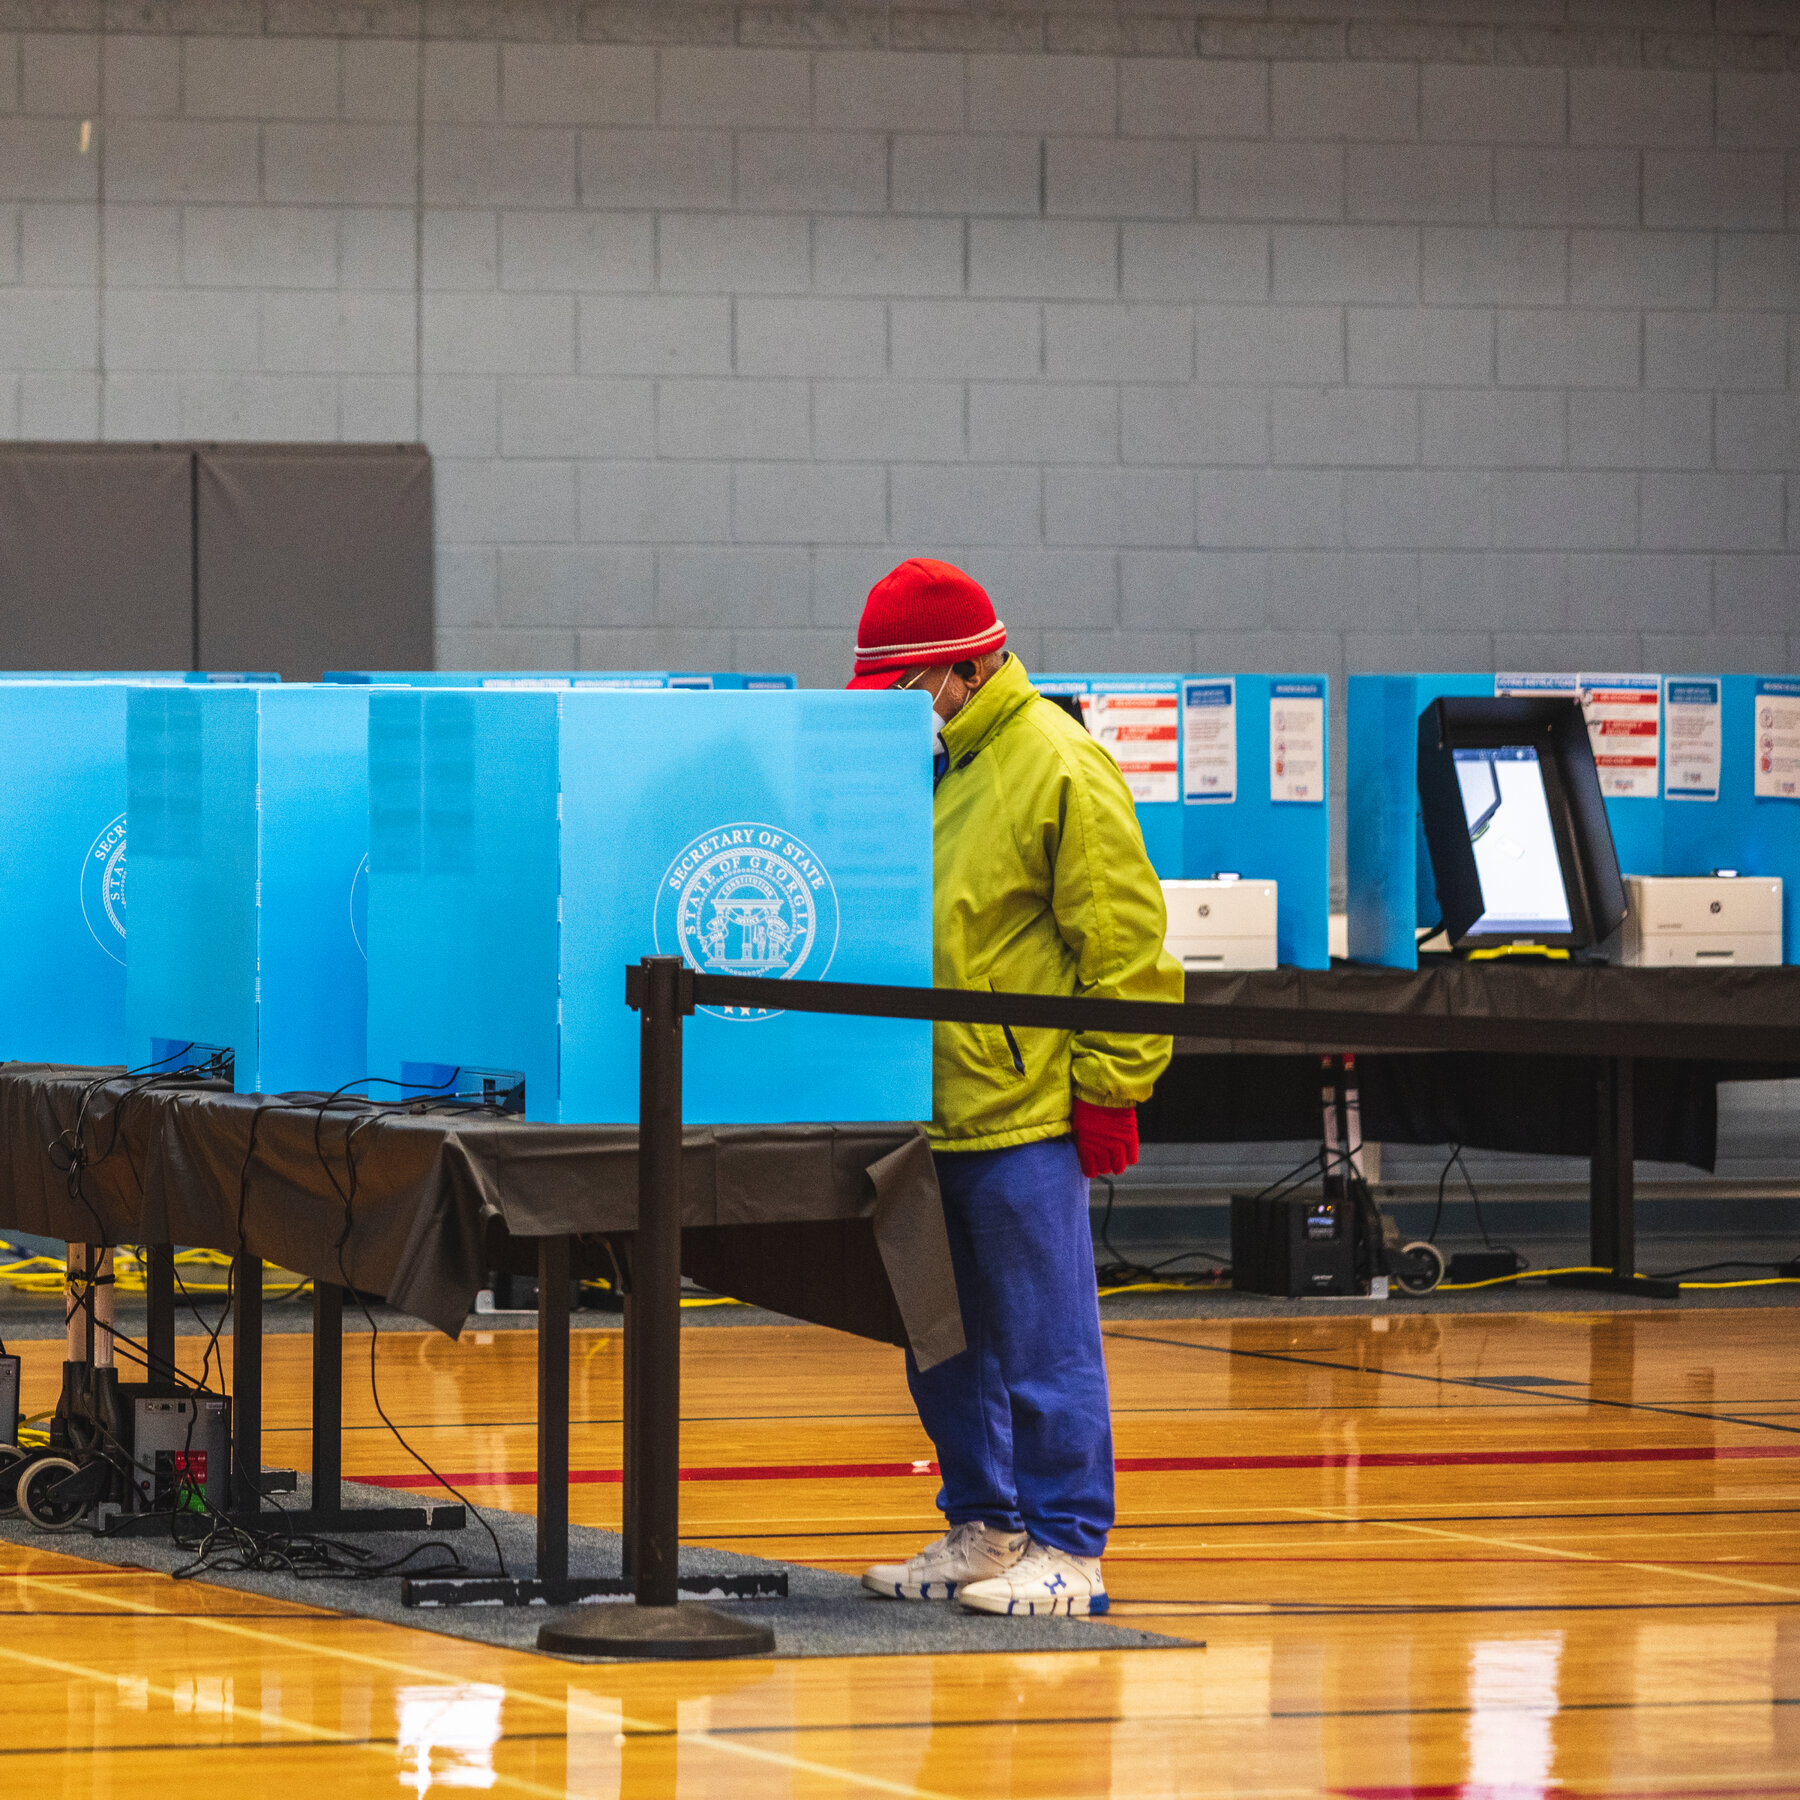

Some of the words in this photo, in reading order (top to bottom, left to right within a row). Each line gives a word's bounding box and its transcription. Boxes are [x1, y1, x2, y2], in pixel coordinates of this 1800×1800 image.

[95, 819, 127, 861] SECR
[668, 829, 755, 890] SECRETARY
[758, 831, 783, 848] OF
[783, 842, 826, 890] STATE
[685, 871, 716, 935] STATE
[719, 857, 741, 873] OF
[749, 856, 808, 935] GEORGIA
